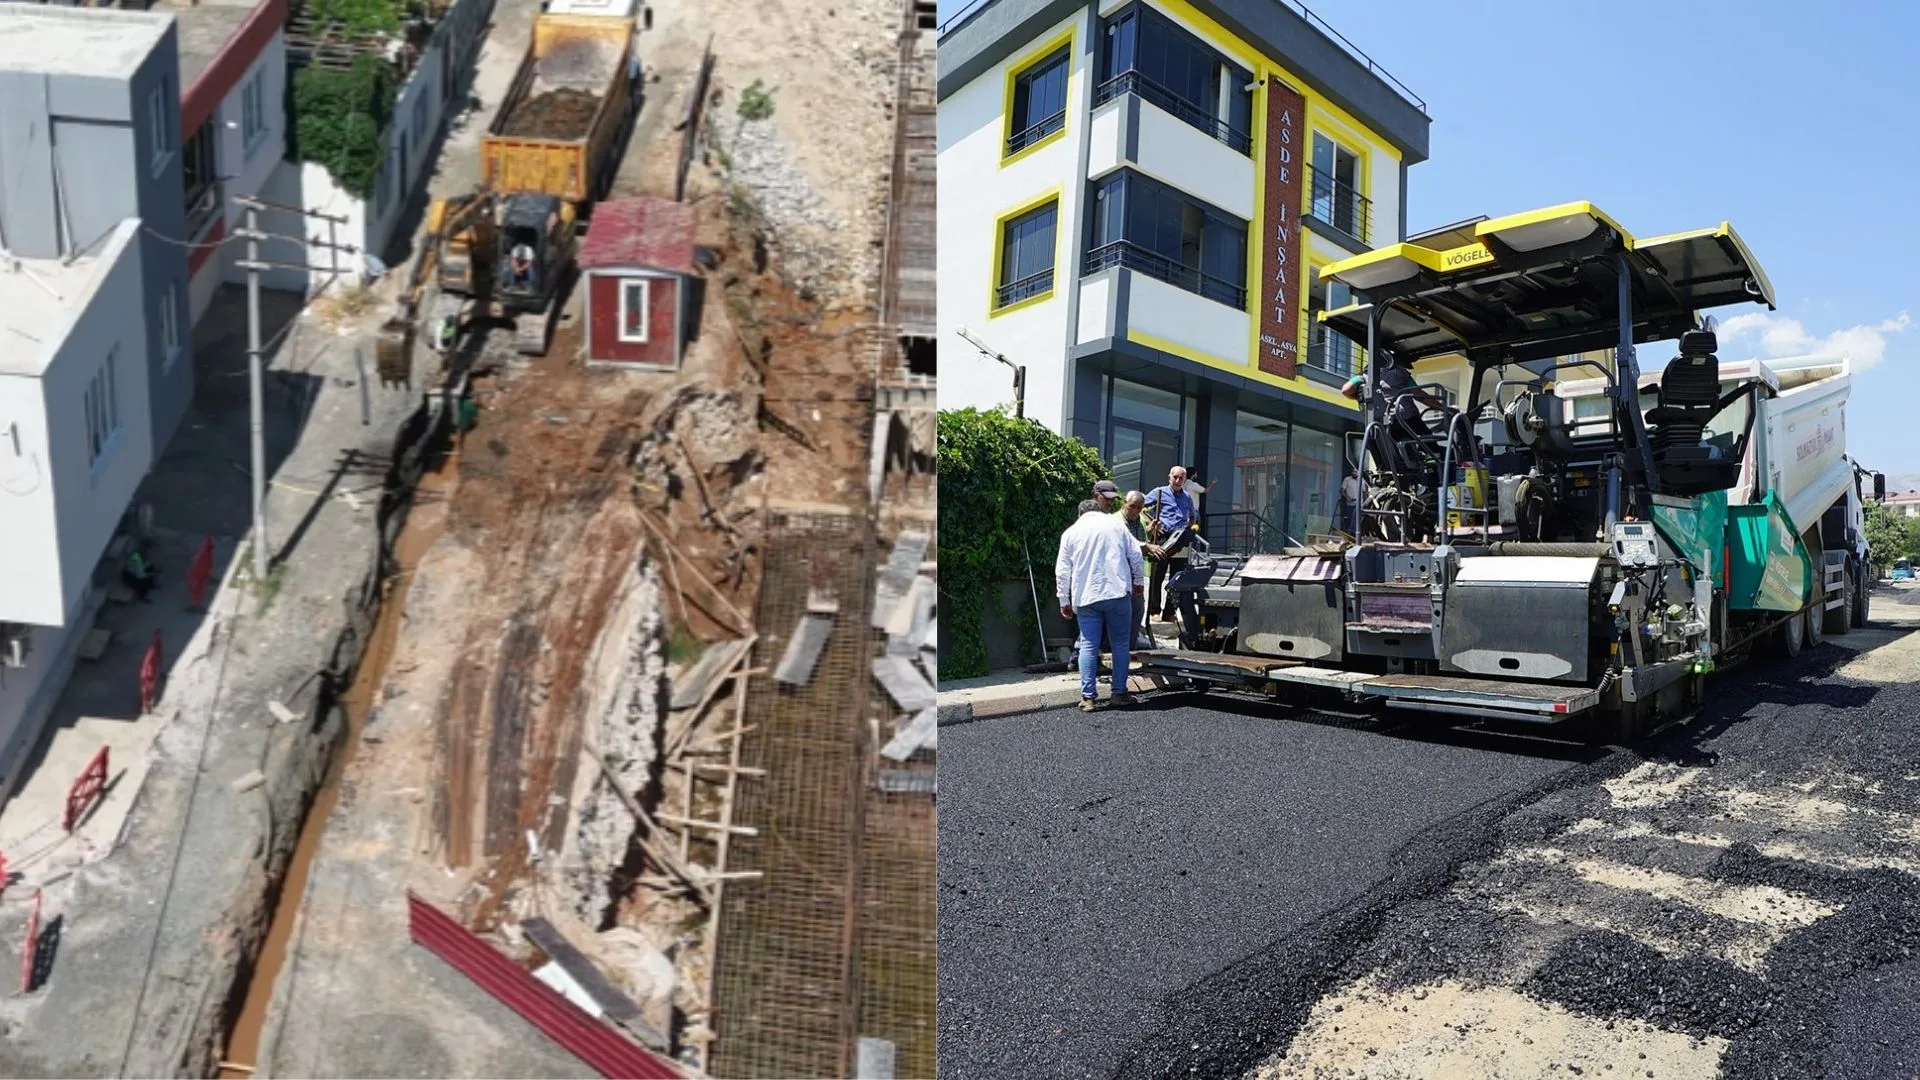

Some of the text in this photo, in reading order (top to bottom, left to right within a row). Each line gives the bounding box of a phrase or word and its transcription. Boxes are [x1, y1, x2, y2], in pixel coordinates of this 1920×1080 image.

[1275, 110, 1291, 324] ASDE İNŞAAT
[1447, 249, 1490, 266] VÖGELE
[1271, 347, 1286, 359] APT.
